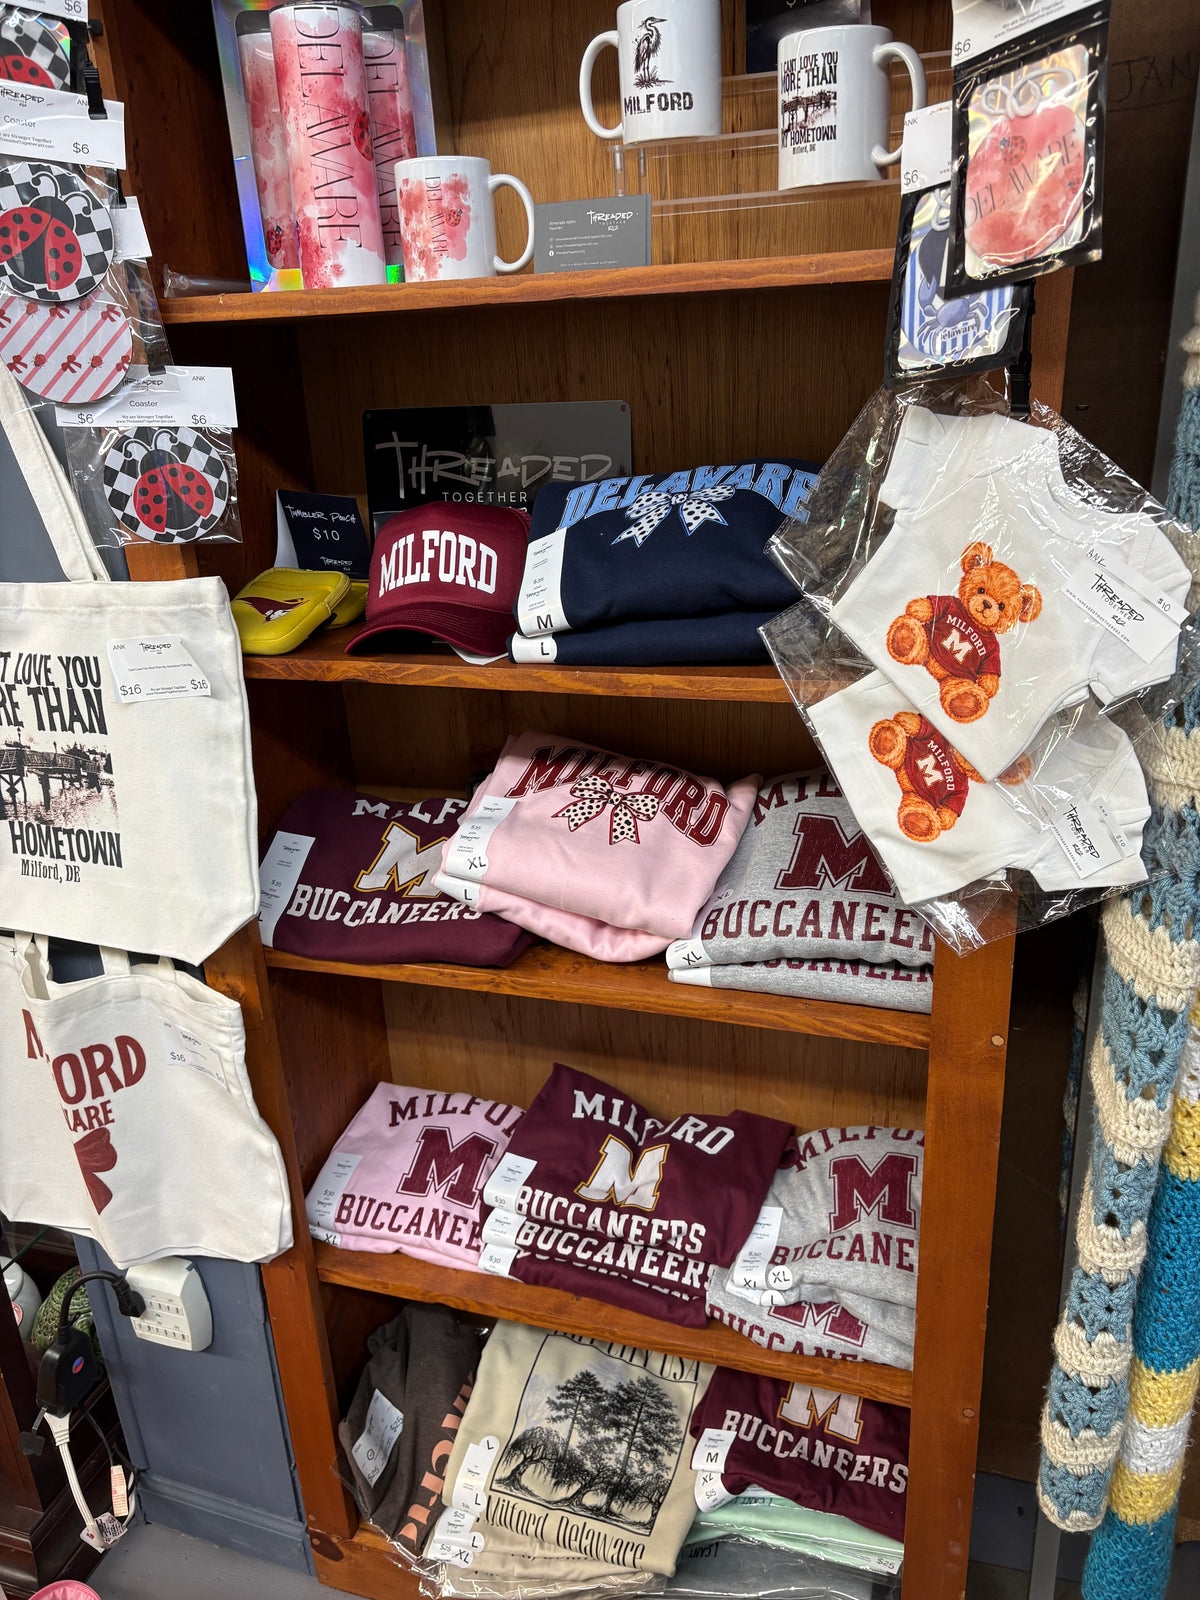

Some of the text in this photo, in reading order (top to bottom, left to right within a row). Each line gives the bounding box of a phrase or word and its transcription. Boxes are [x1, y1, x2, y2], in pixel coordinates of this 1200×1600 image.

[64, 0, 82, 15] $6
[954, 38, 972, 57] $6
[799, 53, 818, 71] LOVE
[821, 51, 839, 66] YOU
[806, 65, 838, 88] THAN
[623, 91, 694, 117] MILFORD
[293, 6, 363, 250] DELAWARE
[790, 124, 838, 146] HOMETOWN
[72, 141, 90, 155] $6
[903, 169, 920, 188] $6
[129, 399, 159, 408] Coaster
[77, 412, 95, 425] $6
[191, 413, 208, 426] $6
[375, 431, 614, 498] THREADED
[442, 490, 529, 504] TOGETHER
[556, 462, 819, 532] DELAWARE
[312, 526, 340, 542] $10
[377, 529, 498, 599] MILFORD
[1090, 573, 1145, 624] THREADED
[536, 614, 554, 630] M
[941, 627, 975, 665] M
[945, 613, 988, 658] MILFORD
[541, 642, 550, 656] L
[14, 652, 55, 687] LOVE
[57, 655, 102, 689] YOU
[120, 684, 142, 697] $16
[190, 678, 209, 691] $16
[27, 686, 109, 736] THAN
[917, 753, 945, 788] M
[926, 739, 956, 792] MILFORD
[503, 744, 732, 848] MILFORD
[1063, 803, 1101, 860] THREADED
[8, 819, 123, 870] HOMETOWN
[773, 811, 898, 899] M
[353, 820, 449, 899] M
[467, 856, 487, 870] XL
[20, 858, 82, 884] Milford, DE
[286, 883, 484, 928] BUCCANEERS
[464, 888, 473, 901] L
[682, 950, 703, 966] XL
[396, 1126, 499, 1210] M
[572, 1133, 671, 1212] M
[827, 1152, 919, 1235] M
[515, 1184, 707, 1256] BUCCANEERS
[323, 1232, 339, 1246] XL
[772, 1270, 791, 1284] XL
[770, 1294, 779, 1306] L
[486, 1439, 495, 1451] L
[720, 1408, 909, 1495] BUCCANEERS
[706, 1451, 719, 1464] M
[702, 1472, 715, 1486] XL
[474, 1492, 482, 1506] L
[484, 1494, 550, 1543] Milford
[471, 1535, 479, 1549] L
[875, 1557, 896, 1571] $25
